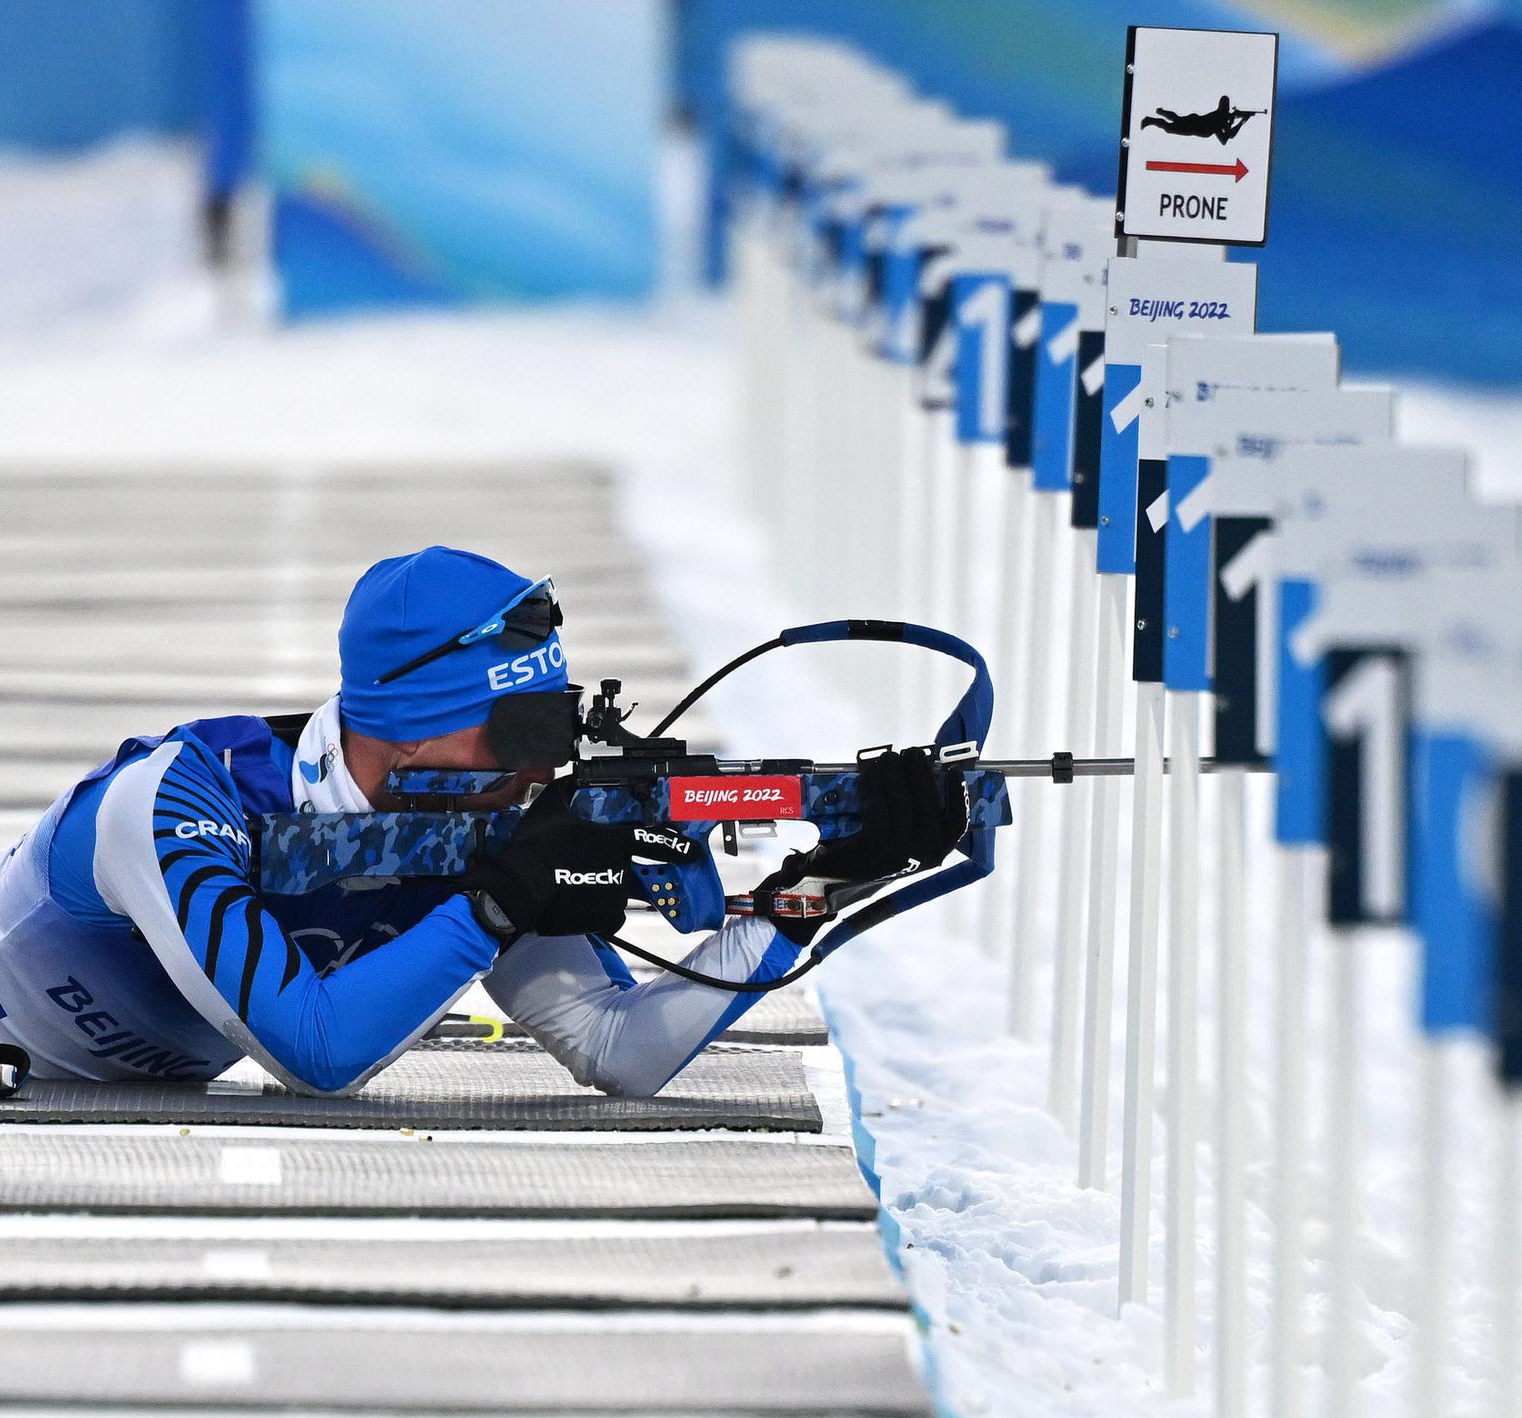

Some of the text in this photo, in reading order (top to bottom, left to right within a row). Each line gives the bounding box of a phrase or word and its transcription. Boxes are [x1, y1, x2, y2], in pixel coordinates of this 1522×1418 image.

[1159, 193, 1229, 221] PRONE
[1129, 298, 1231, 323] BEIJING 2022
[486, 641, 564, 691] ESTO
[684, 788, 785, 807] BEIJING 2022
